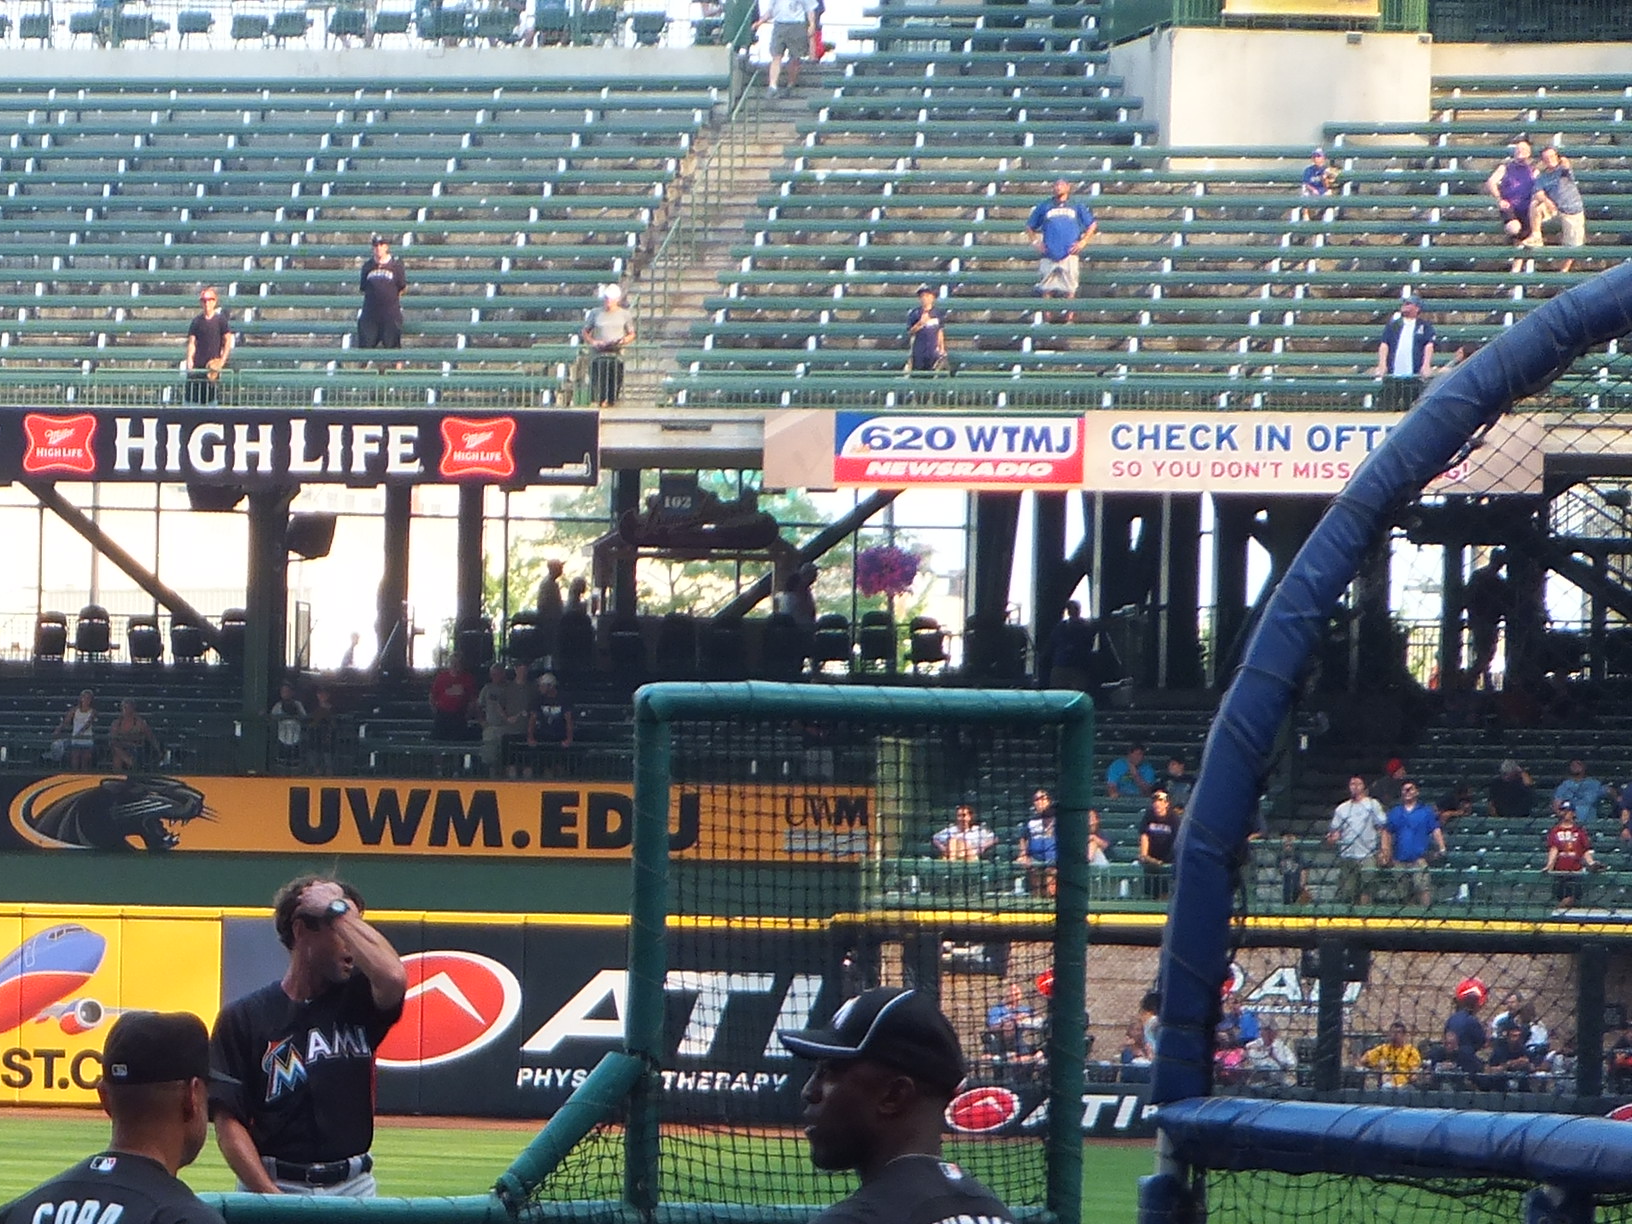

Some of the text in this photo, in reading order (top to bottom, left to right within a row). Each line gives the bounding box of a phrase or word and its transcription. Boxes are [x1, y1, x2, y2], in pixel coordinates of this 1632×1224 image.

[113, 417, 421, 474] HIGH LIFE
[861, 425, 1072, 454] 620 WTMJ
[1110, 422, 1393, 454] CHECK IN OFT
[36, 447, 84, 459] HIGH LIFE
[453, 451, 502, 462] HIGH LIFE
[864, 461, 1054, 479] NEWSRADIO
[1111, 461, 1351, 481] SO YOU DON'T MISS
[784, 795, 867, 828] UWM
[519, 969, 824, 1056] ATI
[662, 1068, 788, 1092] THERAPY
